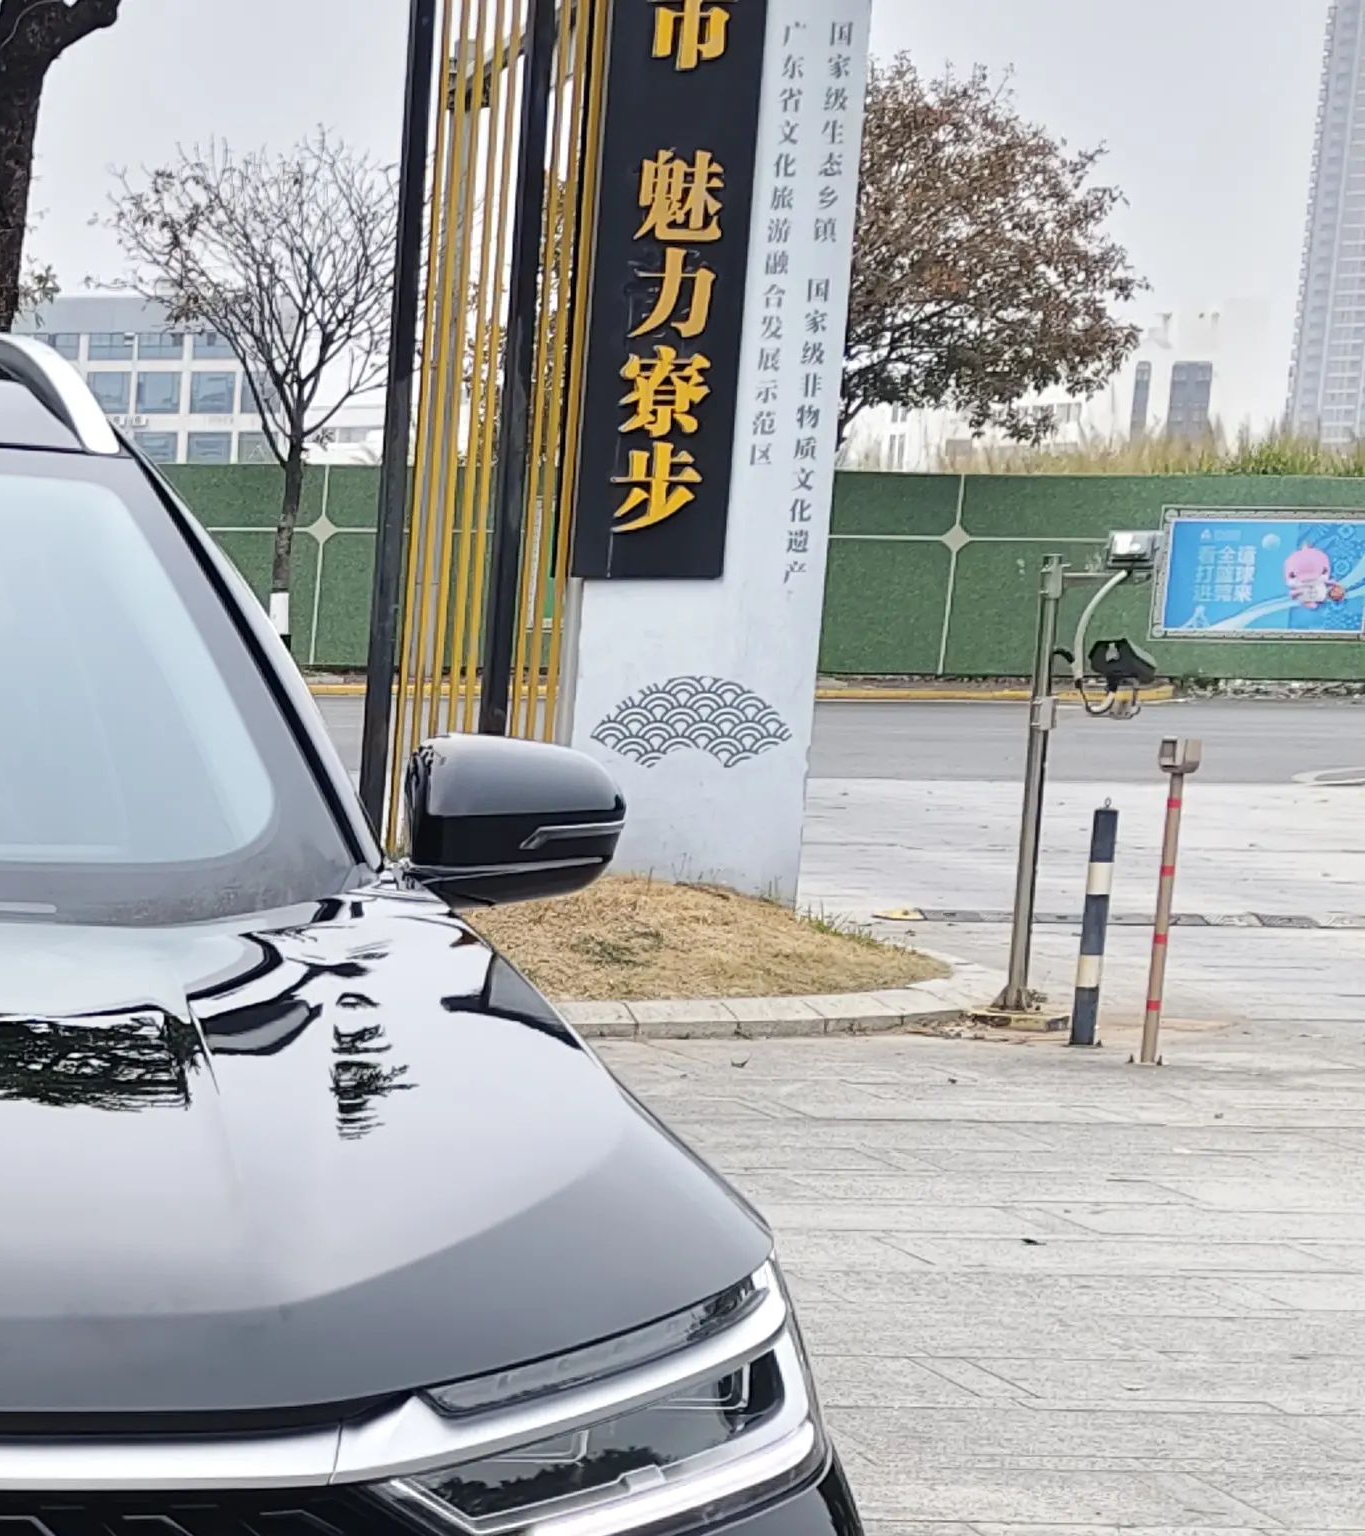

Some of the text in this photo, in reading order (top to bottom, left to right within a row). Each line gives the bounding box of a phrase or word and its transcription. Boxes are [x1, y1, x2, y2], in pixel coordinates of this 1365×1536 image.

[609, 148, 726, 533] 魅力寮步
[749, 20, 807, 467] 广东省文化旅游融合发展示范区
[782, 20, 854, 585] 国家级生态乡镇 国家级非物质文化遗产
